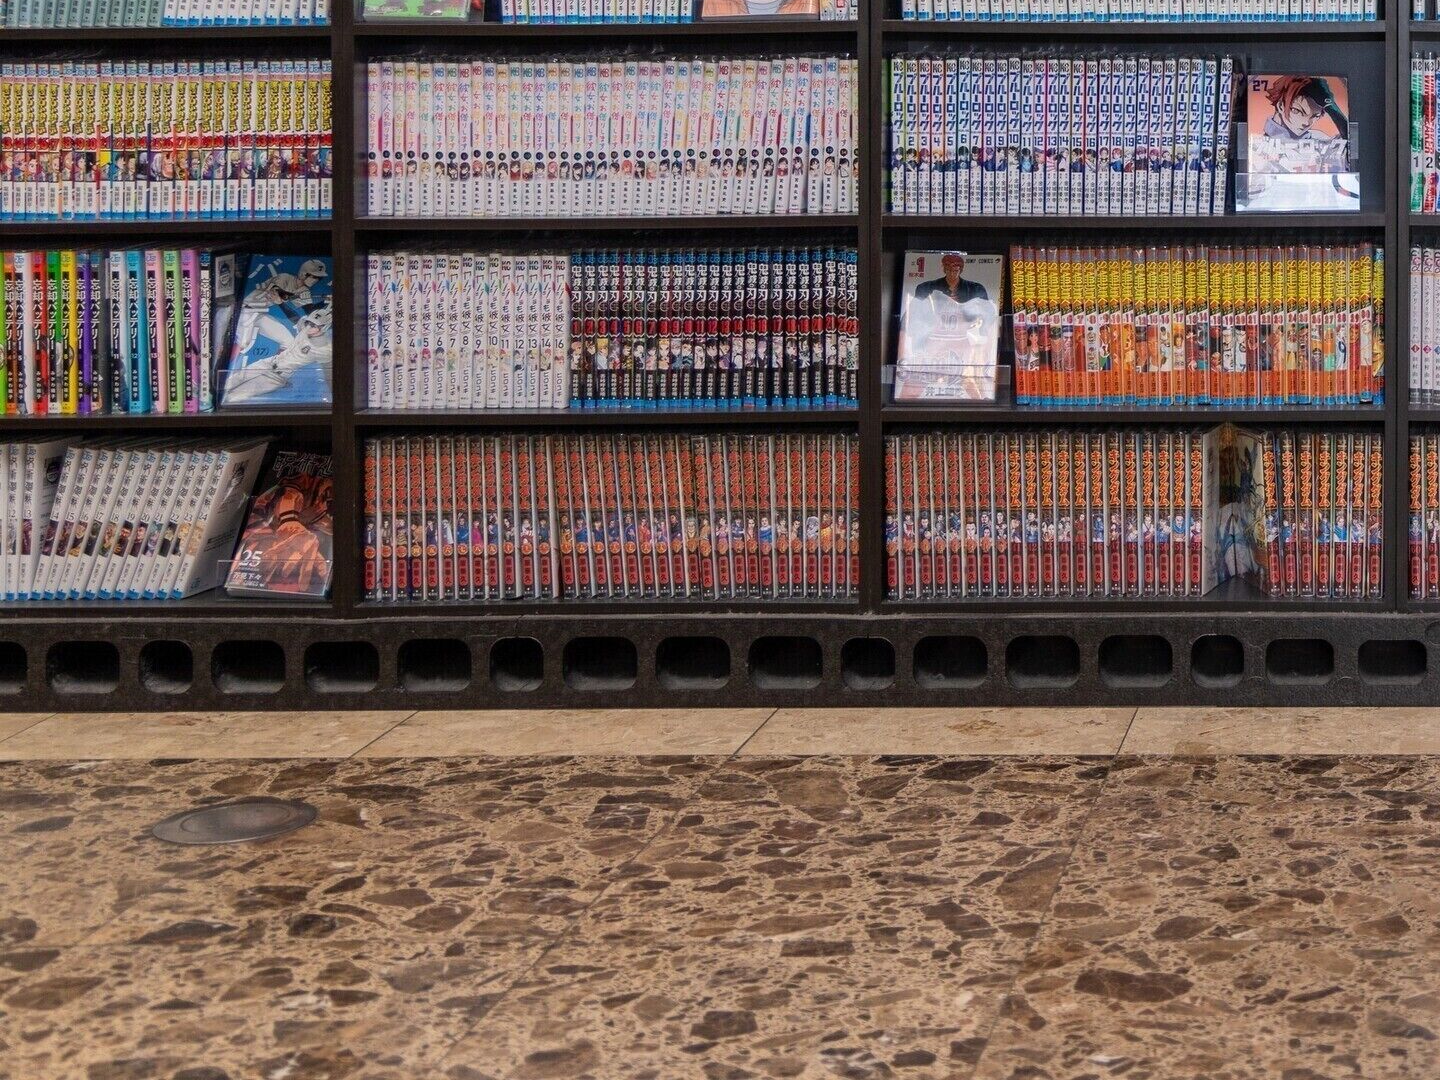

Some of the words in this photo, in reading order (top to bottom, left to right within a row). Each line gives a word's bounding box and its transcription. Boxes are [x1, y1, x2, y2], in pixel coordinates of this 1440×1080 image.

[1253, 80, 1268, 91] 27
[907, 74, 917, 131] ブルーロック
[959, 72, 970, 129] ブルーロック
[1009, 71, 1020, 128] ブルーロック
[1086, 74, 1098, 131] ブルーロック
[909, 136, 915, 147] 2
[960, 134, 967, 144] 6
[1009, 133, 1019, 144] 10
[1086, 137, 1096, 147] 16
[571, 265, 582, 301] 鬼滅の刃
[610, 265, 621, 301] 鬼滅の刃
[62, 279, 72, 350] 忘却バッテリー
[111, 278, 121, 350] 忘却バッテリー
[383, 339, 389, 348] 2
[437, 337, 443, 346] 6
[463, 336, 469, 346] 8
[514, 339, 524, 348] 12
[554, 339, 564, 348] 16
[239, 550, 262, 567] 25
